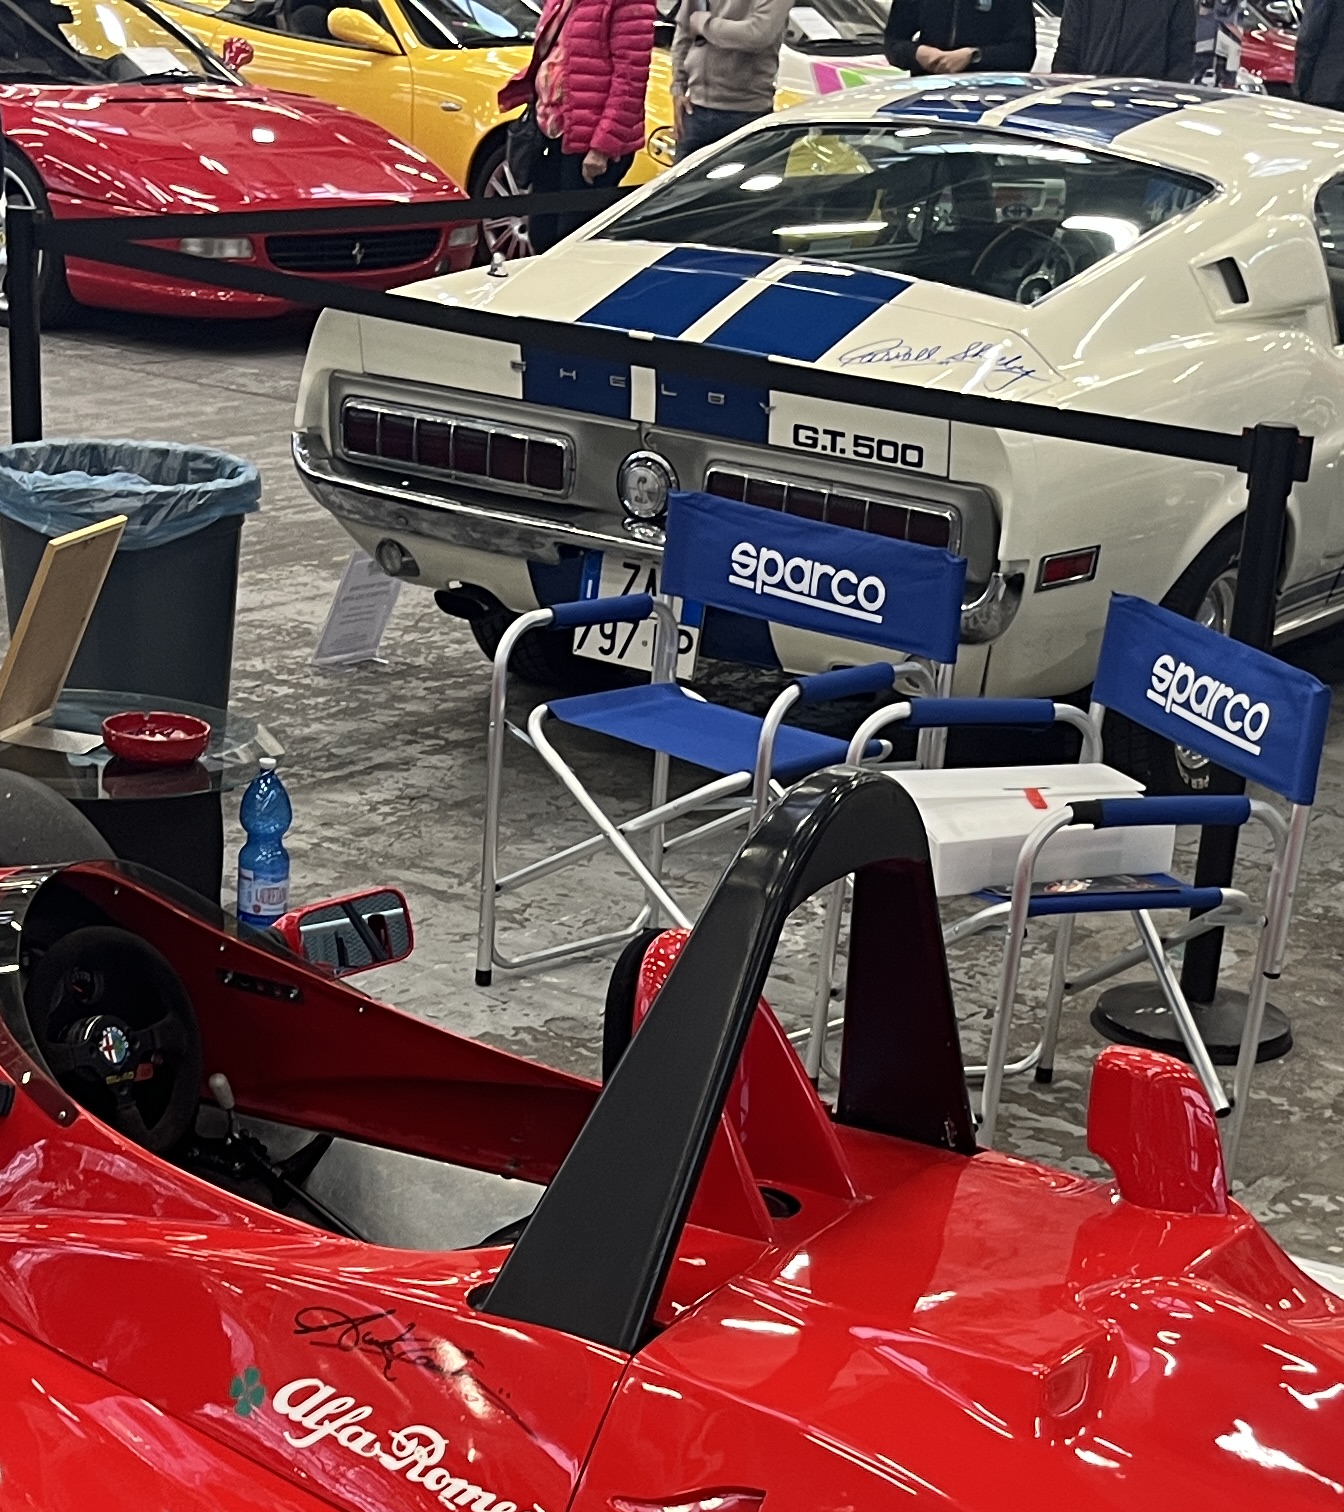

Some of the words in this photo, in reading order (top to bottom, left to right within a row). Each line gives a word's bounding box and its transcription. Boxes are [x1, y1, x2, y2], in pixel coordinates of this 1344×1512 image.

[853, 434, 924, 468] 500
[730, 542, 886, 612] sparco
[1151, 654, 1270, 742] sparco
[272, 1377, 380, 1458] Alfa
